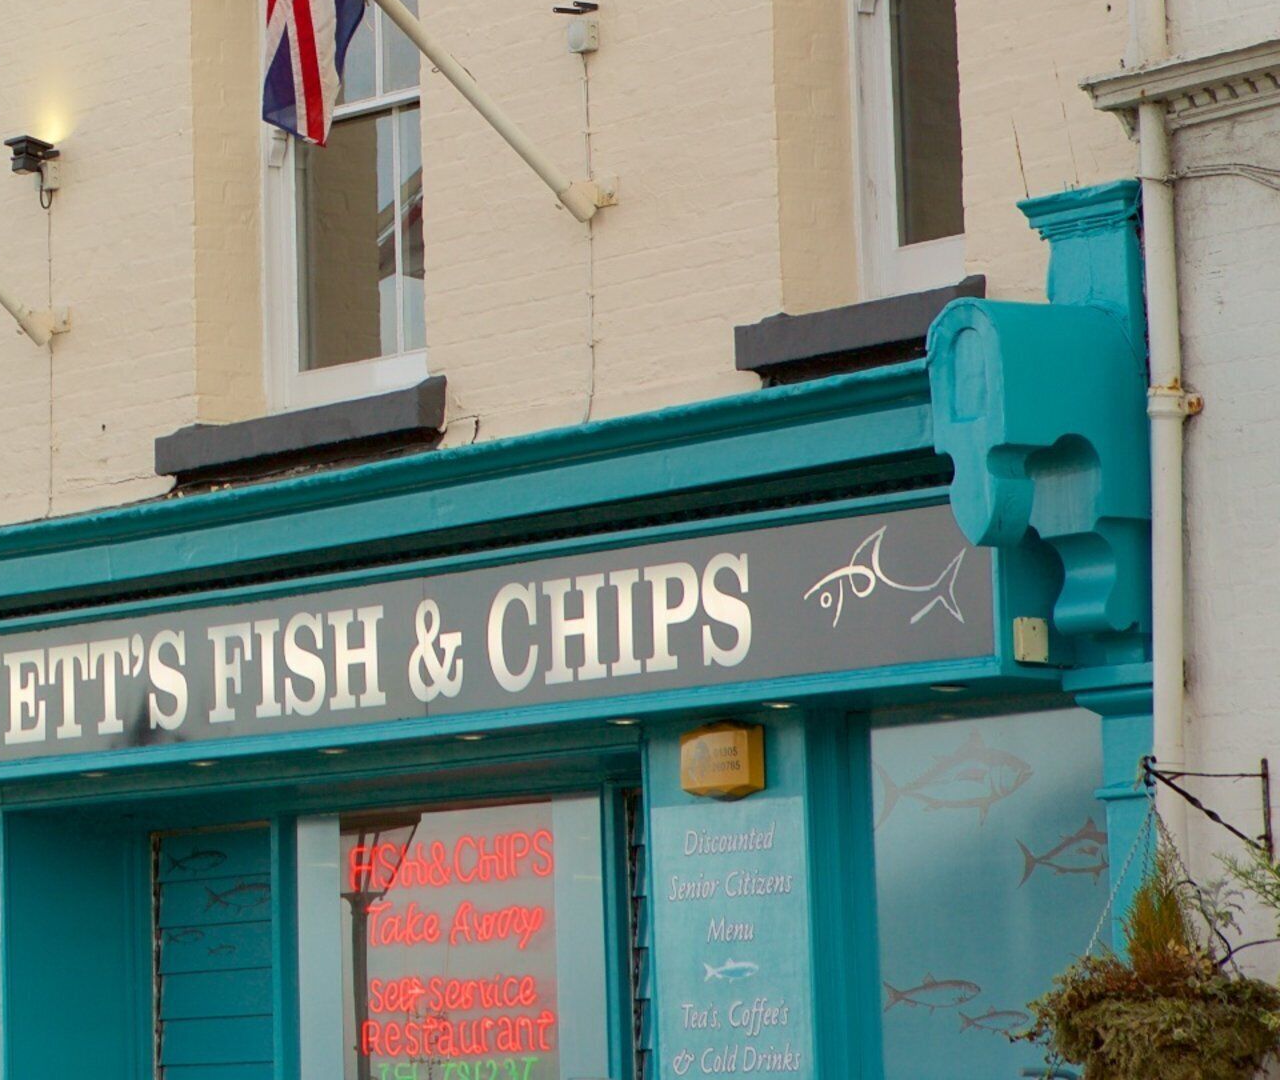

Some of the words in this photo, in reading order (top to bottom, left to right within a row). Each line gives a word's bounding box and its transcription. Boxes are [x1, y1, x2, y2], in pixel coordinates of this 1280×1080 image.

[207, 604, 387, 723] FISH
[407, 598, 464, 703] &
[486, 552, 752, 692] CHIPS
[684, 821, 776, 856] Discounted
[669, 873, 720, 901] Senior
[724, 869, 793, 898] Citizens
[366, 901, 440, 946] Take
[449, 899, 545, 950] Away
[707, 916, 755, 944] Menu
[361, 1010, 556, 1056] Restaurant
[728, 997, 790, 1037] Coffee's
[700, 1043, 739, 1075] Cold
[742, 1041, 801, 1072] Drinks
